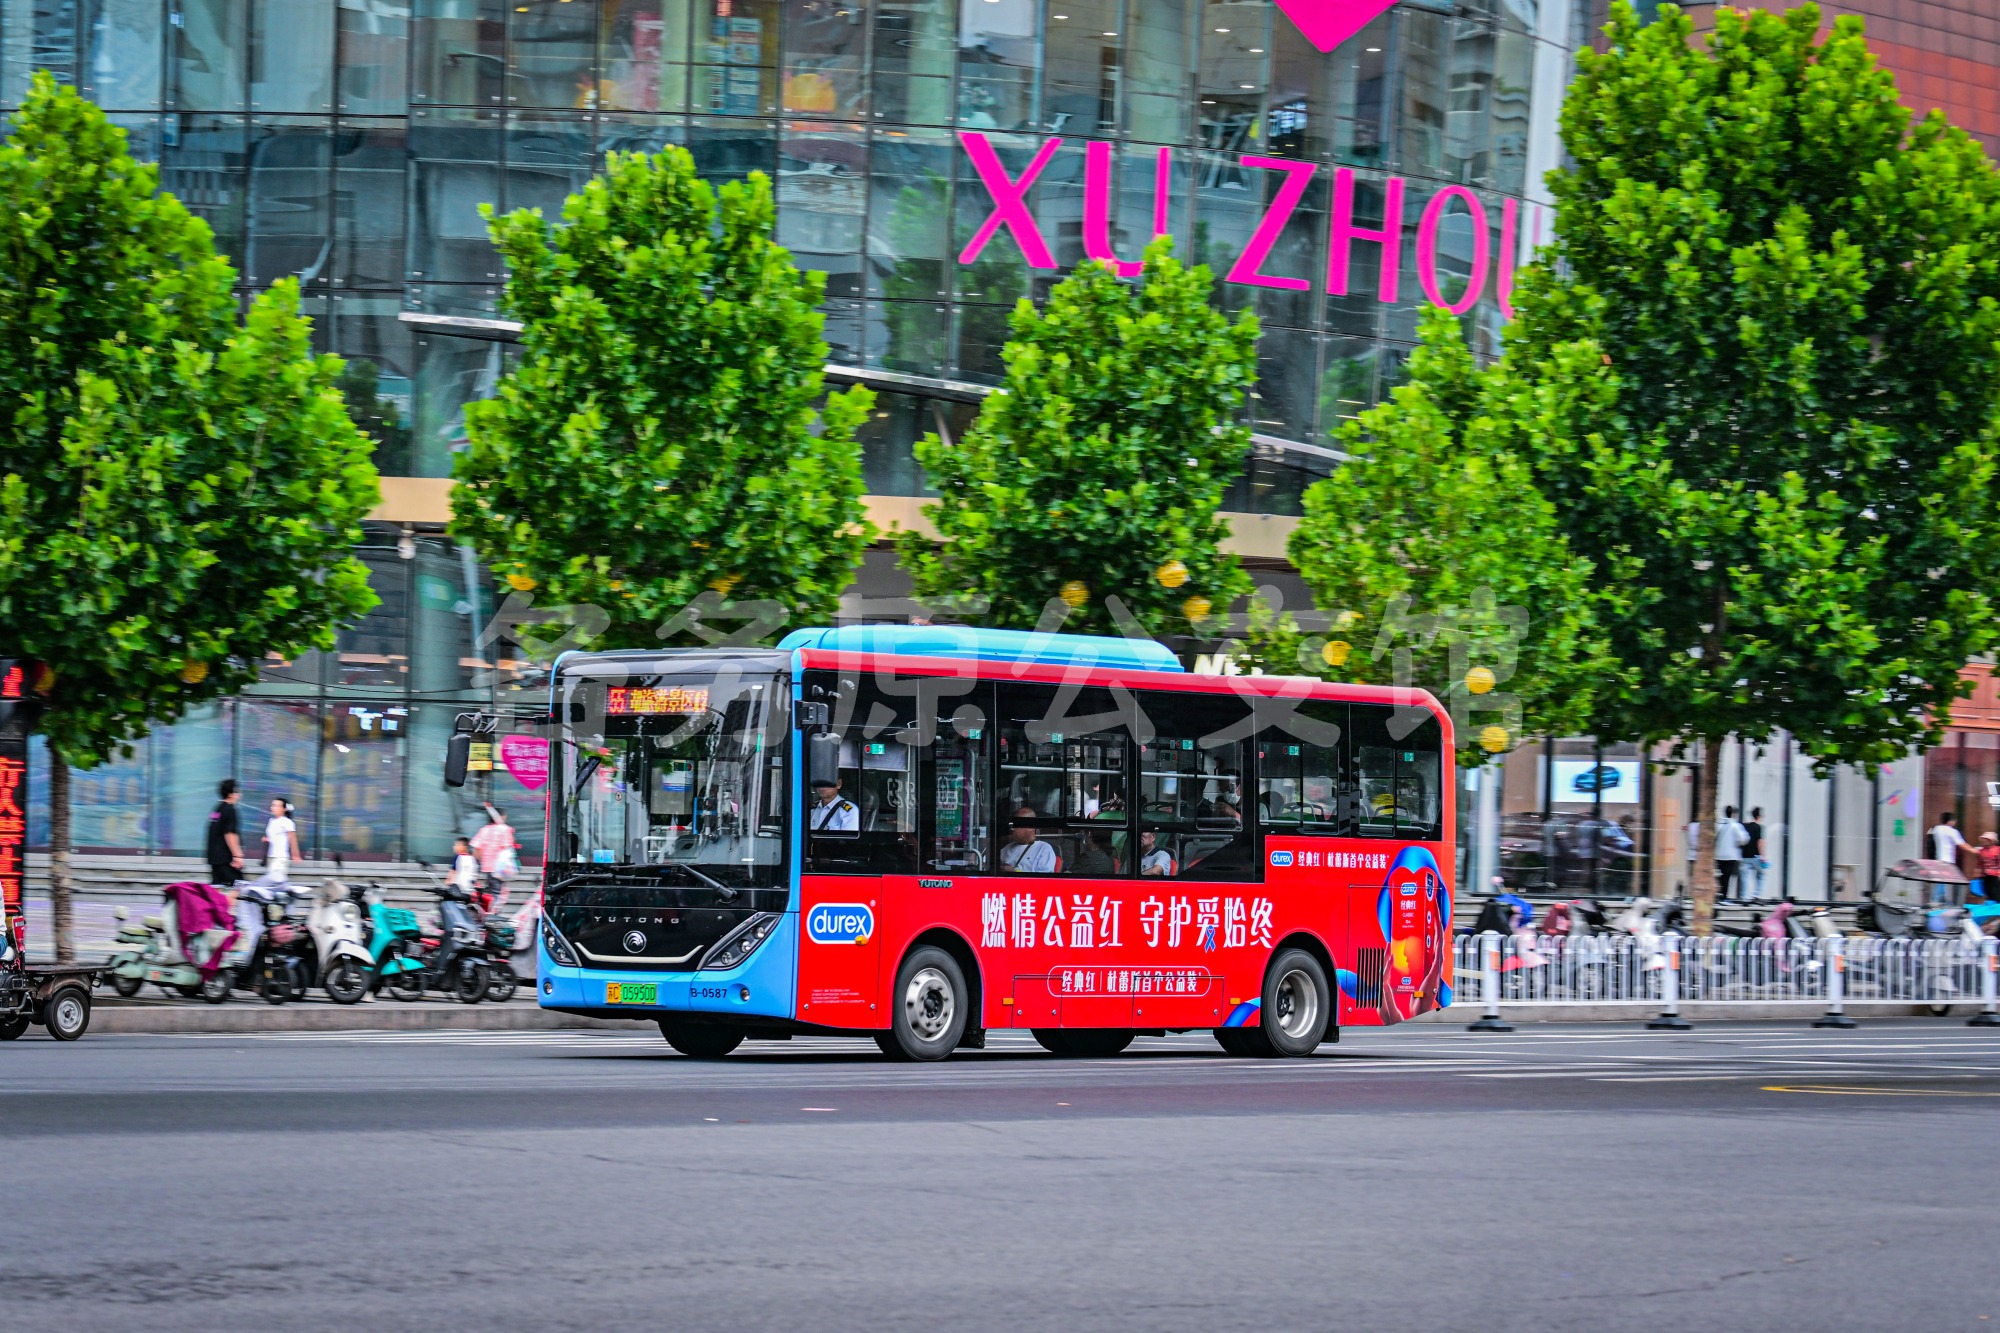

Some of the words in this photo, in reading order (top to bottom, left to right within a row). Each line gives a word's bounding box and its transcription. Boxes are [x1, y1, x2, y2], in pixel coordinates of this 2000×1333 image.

[958, 132, 1170, 277] XU
[1272, 854, 1291, 864] durex
[1298, 851, 1320, 867] 经典红
[1327, 852, 1387, 869] 杜蕾斯首个公益装
[918, 879, 953, 888] YUTONG
[594, 916, 680, 924] YUTONG
[814, 909, 869, 938] durex
[981, 893, 1123, 949] 燃情公益红
[1139, 896, 1274, 949] 守护爱始终
[1062, 970, 1096, 993] 经典红
[1107, 970, 1198, 993] 杜蕾斯首个公益装
[690, 988, 727, 998] B-0587
